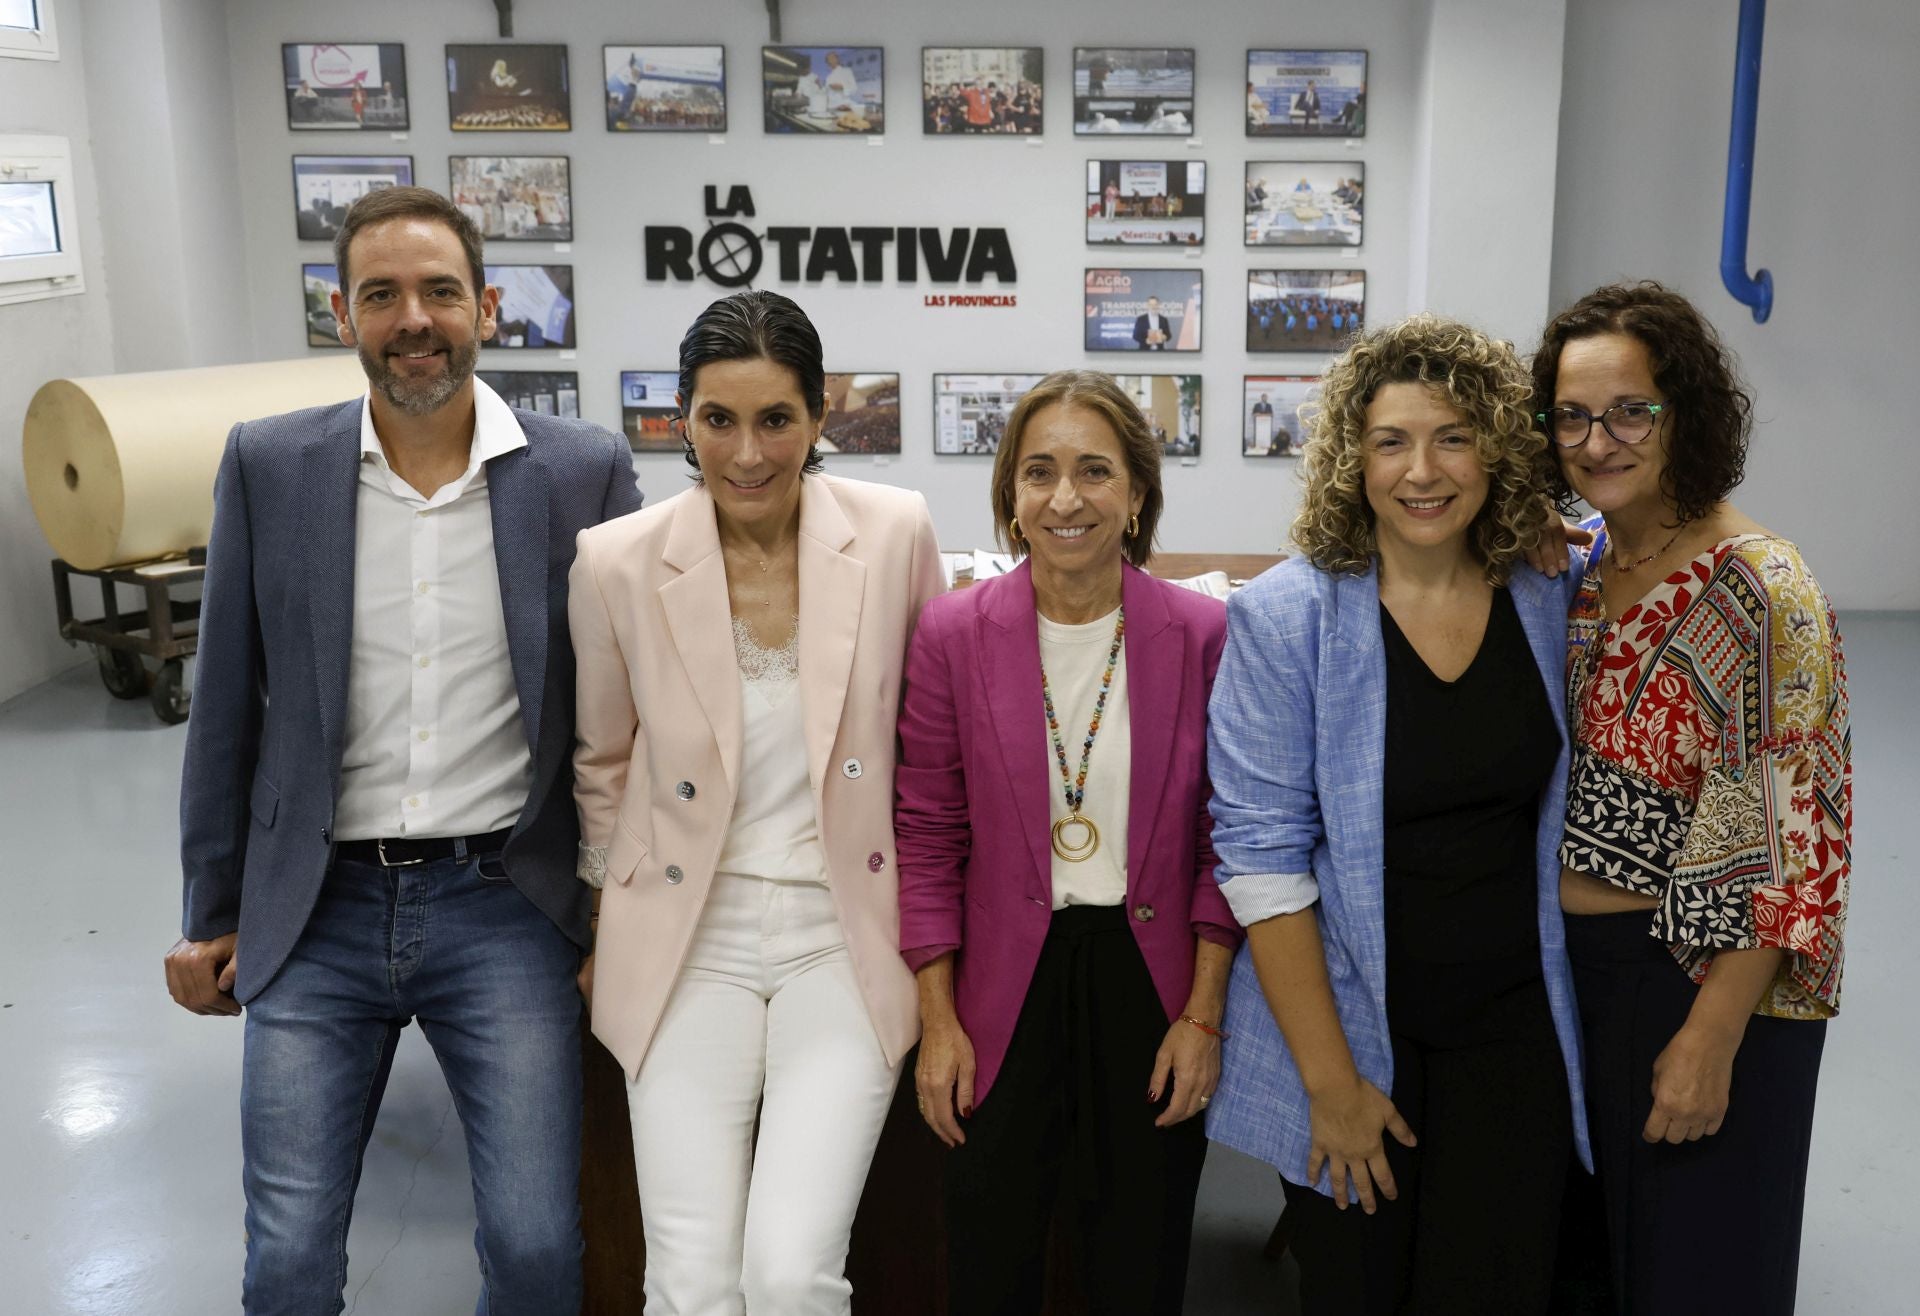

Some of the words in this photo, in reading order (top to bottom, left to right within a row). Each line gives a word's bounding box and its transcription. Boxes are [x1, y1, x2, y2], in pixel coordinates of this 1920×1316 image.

[705, 184, 756, 217] LA
[645, 221, 1017, 286] ROTATIVA
[1096, 276, 1131, 286] AGRO
[925, 295, 945, 306] LAS
[949, 295, 1017, 307] PROVINCIAS
